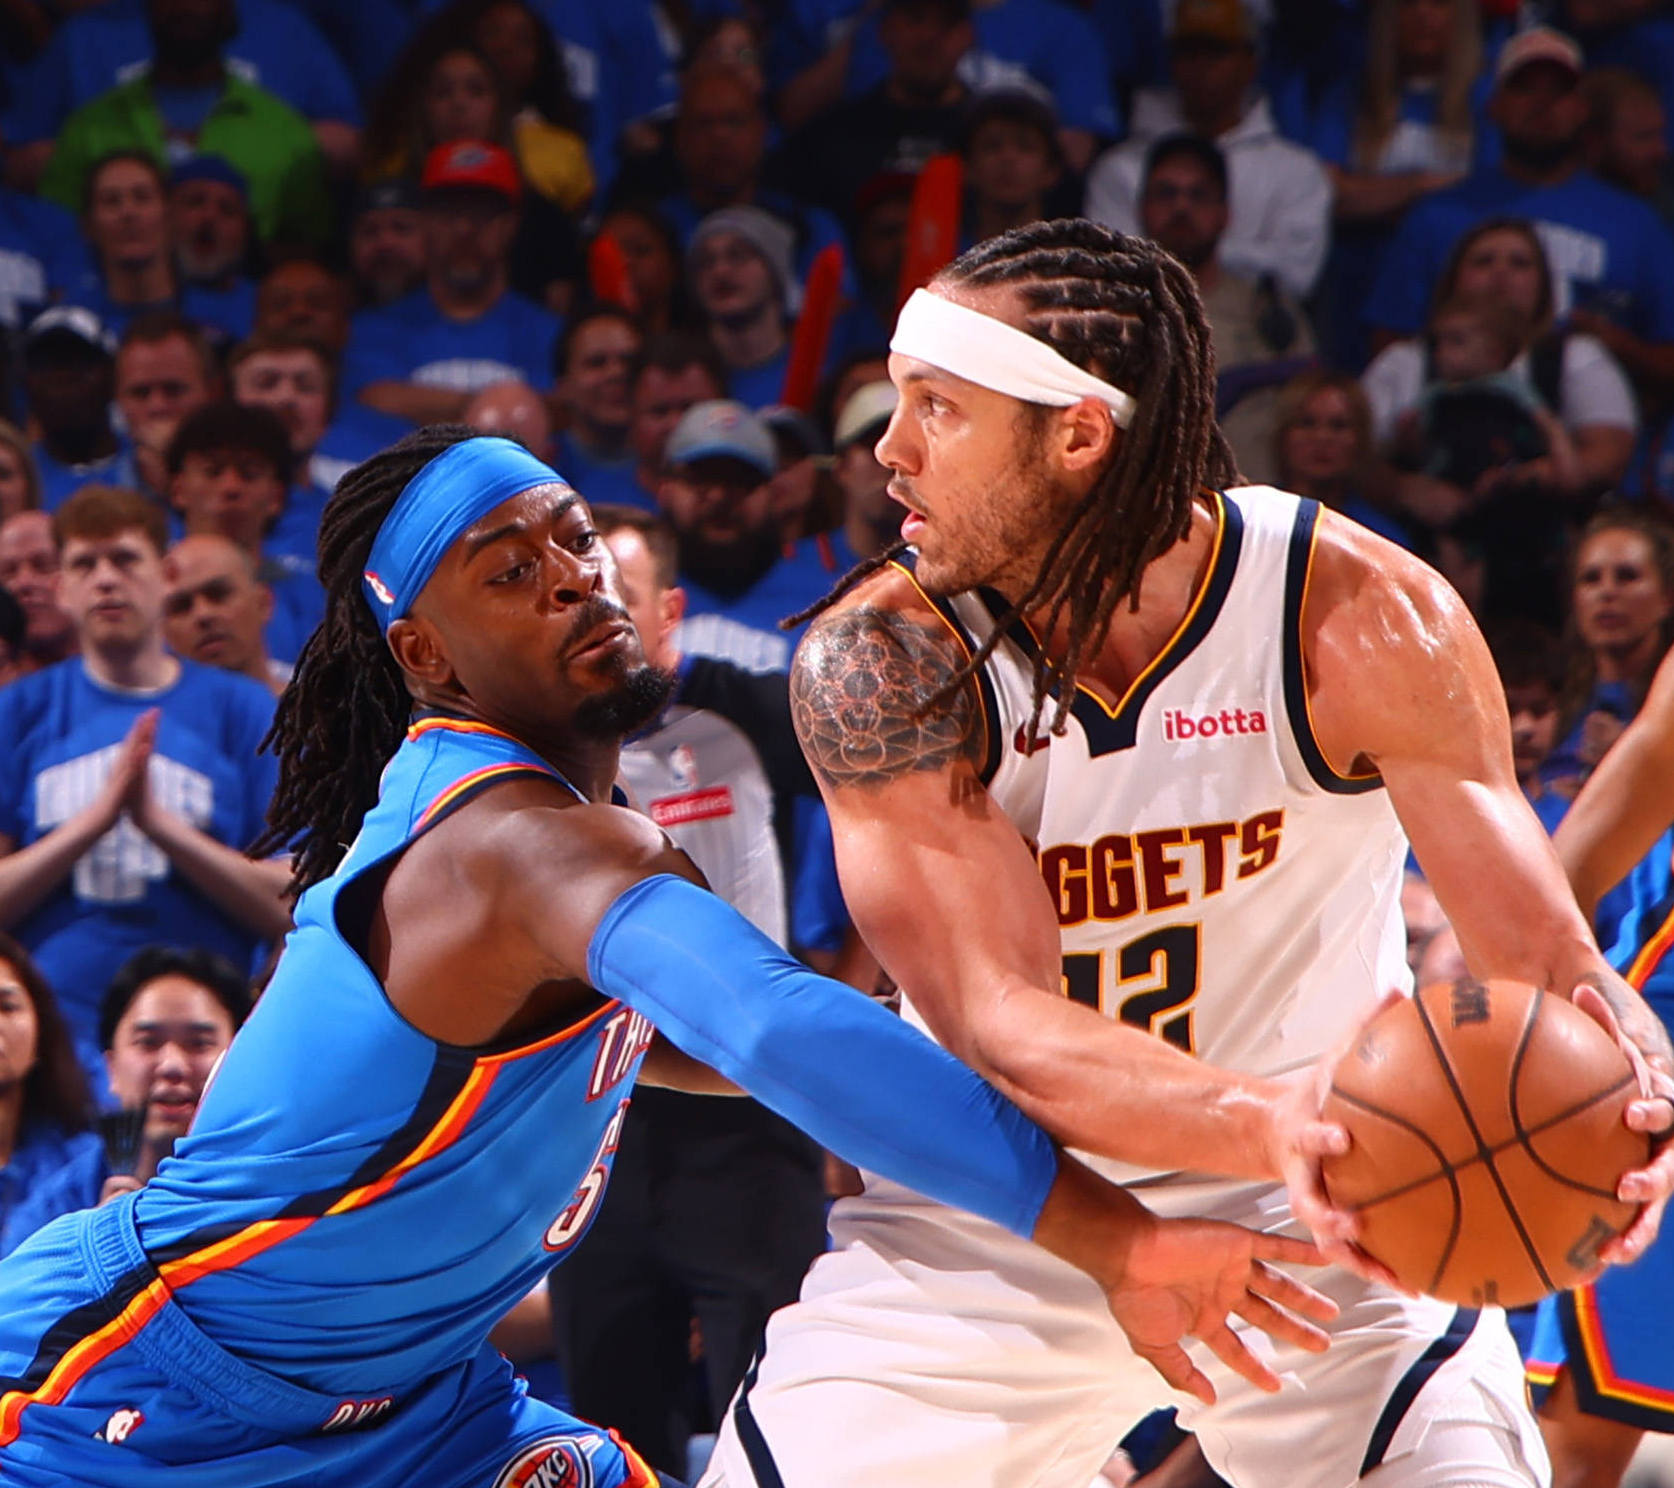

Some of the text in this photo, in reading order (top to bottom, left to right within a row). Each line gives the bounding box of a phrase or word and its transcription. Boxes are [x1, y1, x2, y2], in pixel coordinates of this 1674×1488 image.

[1164, 708, 1267, 741] ibotta
[1026, 806, 1286, 929] GGETS
[1060, 920, 1203, 1057] 12
[541, 1097, 632, 1254] 5
